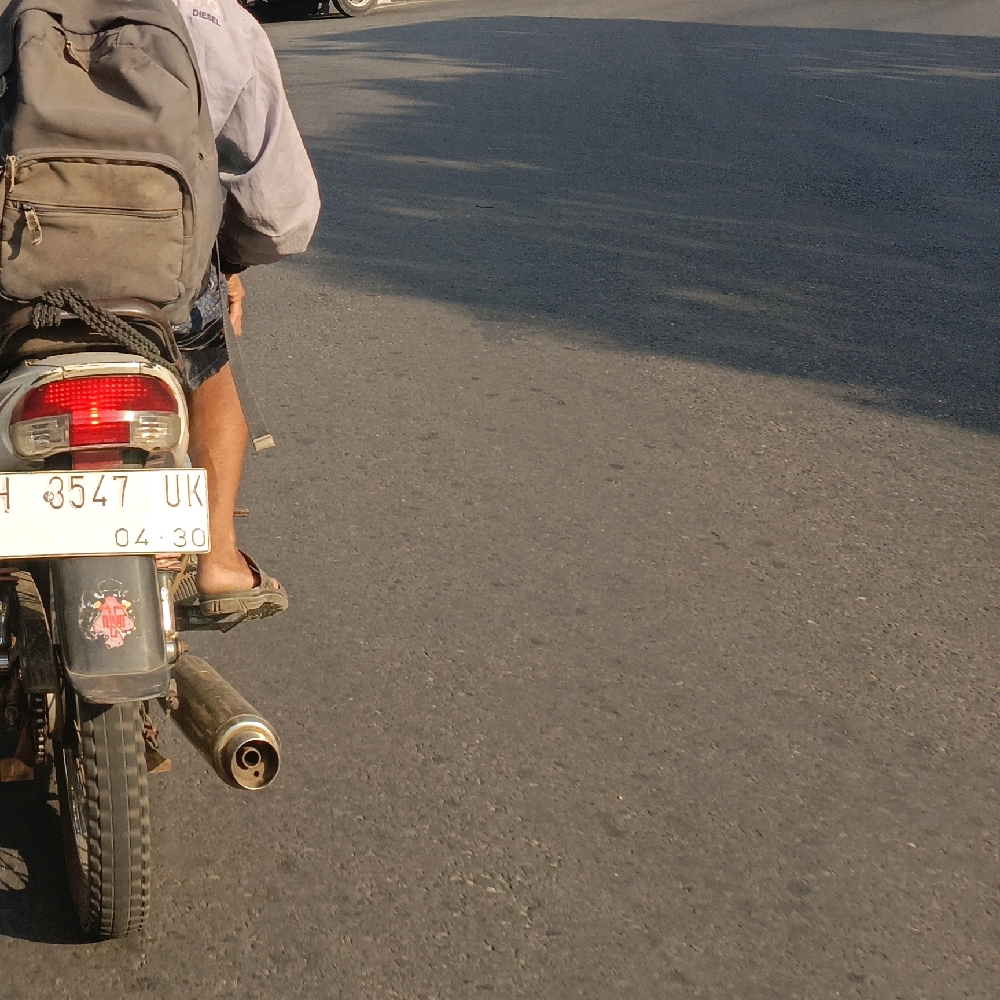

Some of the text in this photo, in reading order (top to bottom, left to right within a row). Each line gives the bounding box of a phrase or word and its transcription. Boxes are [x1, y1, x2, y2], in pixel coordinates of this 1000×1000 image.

[192, 8, 221, 27] DIESEL
[48, 474, 129, 510] 3547
[163, 473, 205, 508] UK
[114, 527, 207, 548] 04 30
